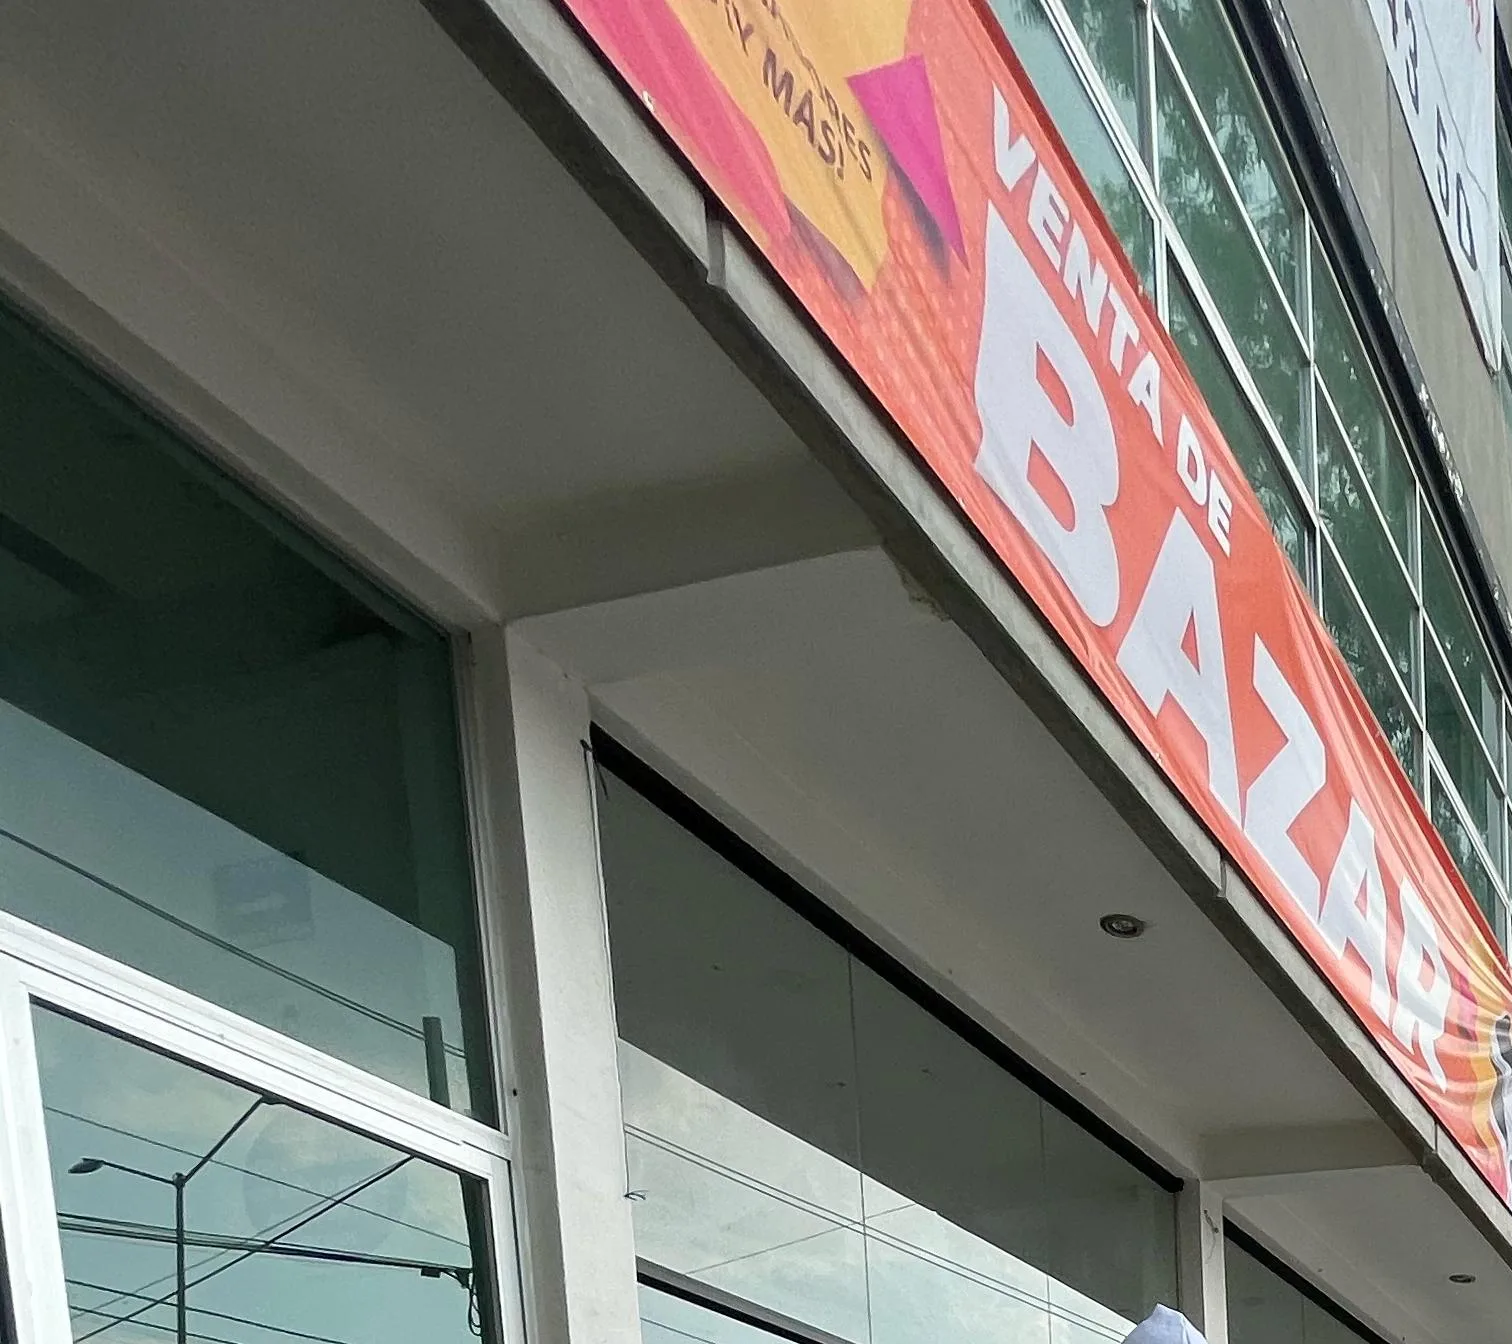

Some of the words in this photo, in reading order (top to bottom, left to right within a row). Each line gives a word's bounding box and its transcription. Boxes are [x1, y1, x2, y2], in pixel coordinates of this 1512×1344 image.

[973, 199, 1453, 1093] BAZAR
[992, 82, 1166, 447] VENTA
[1176, 414, 1233, 557] DE
